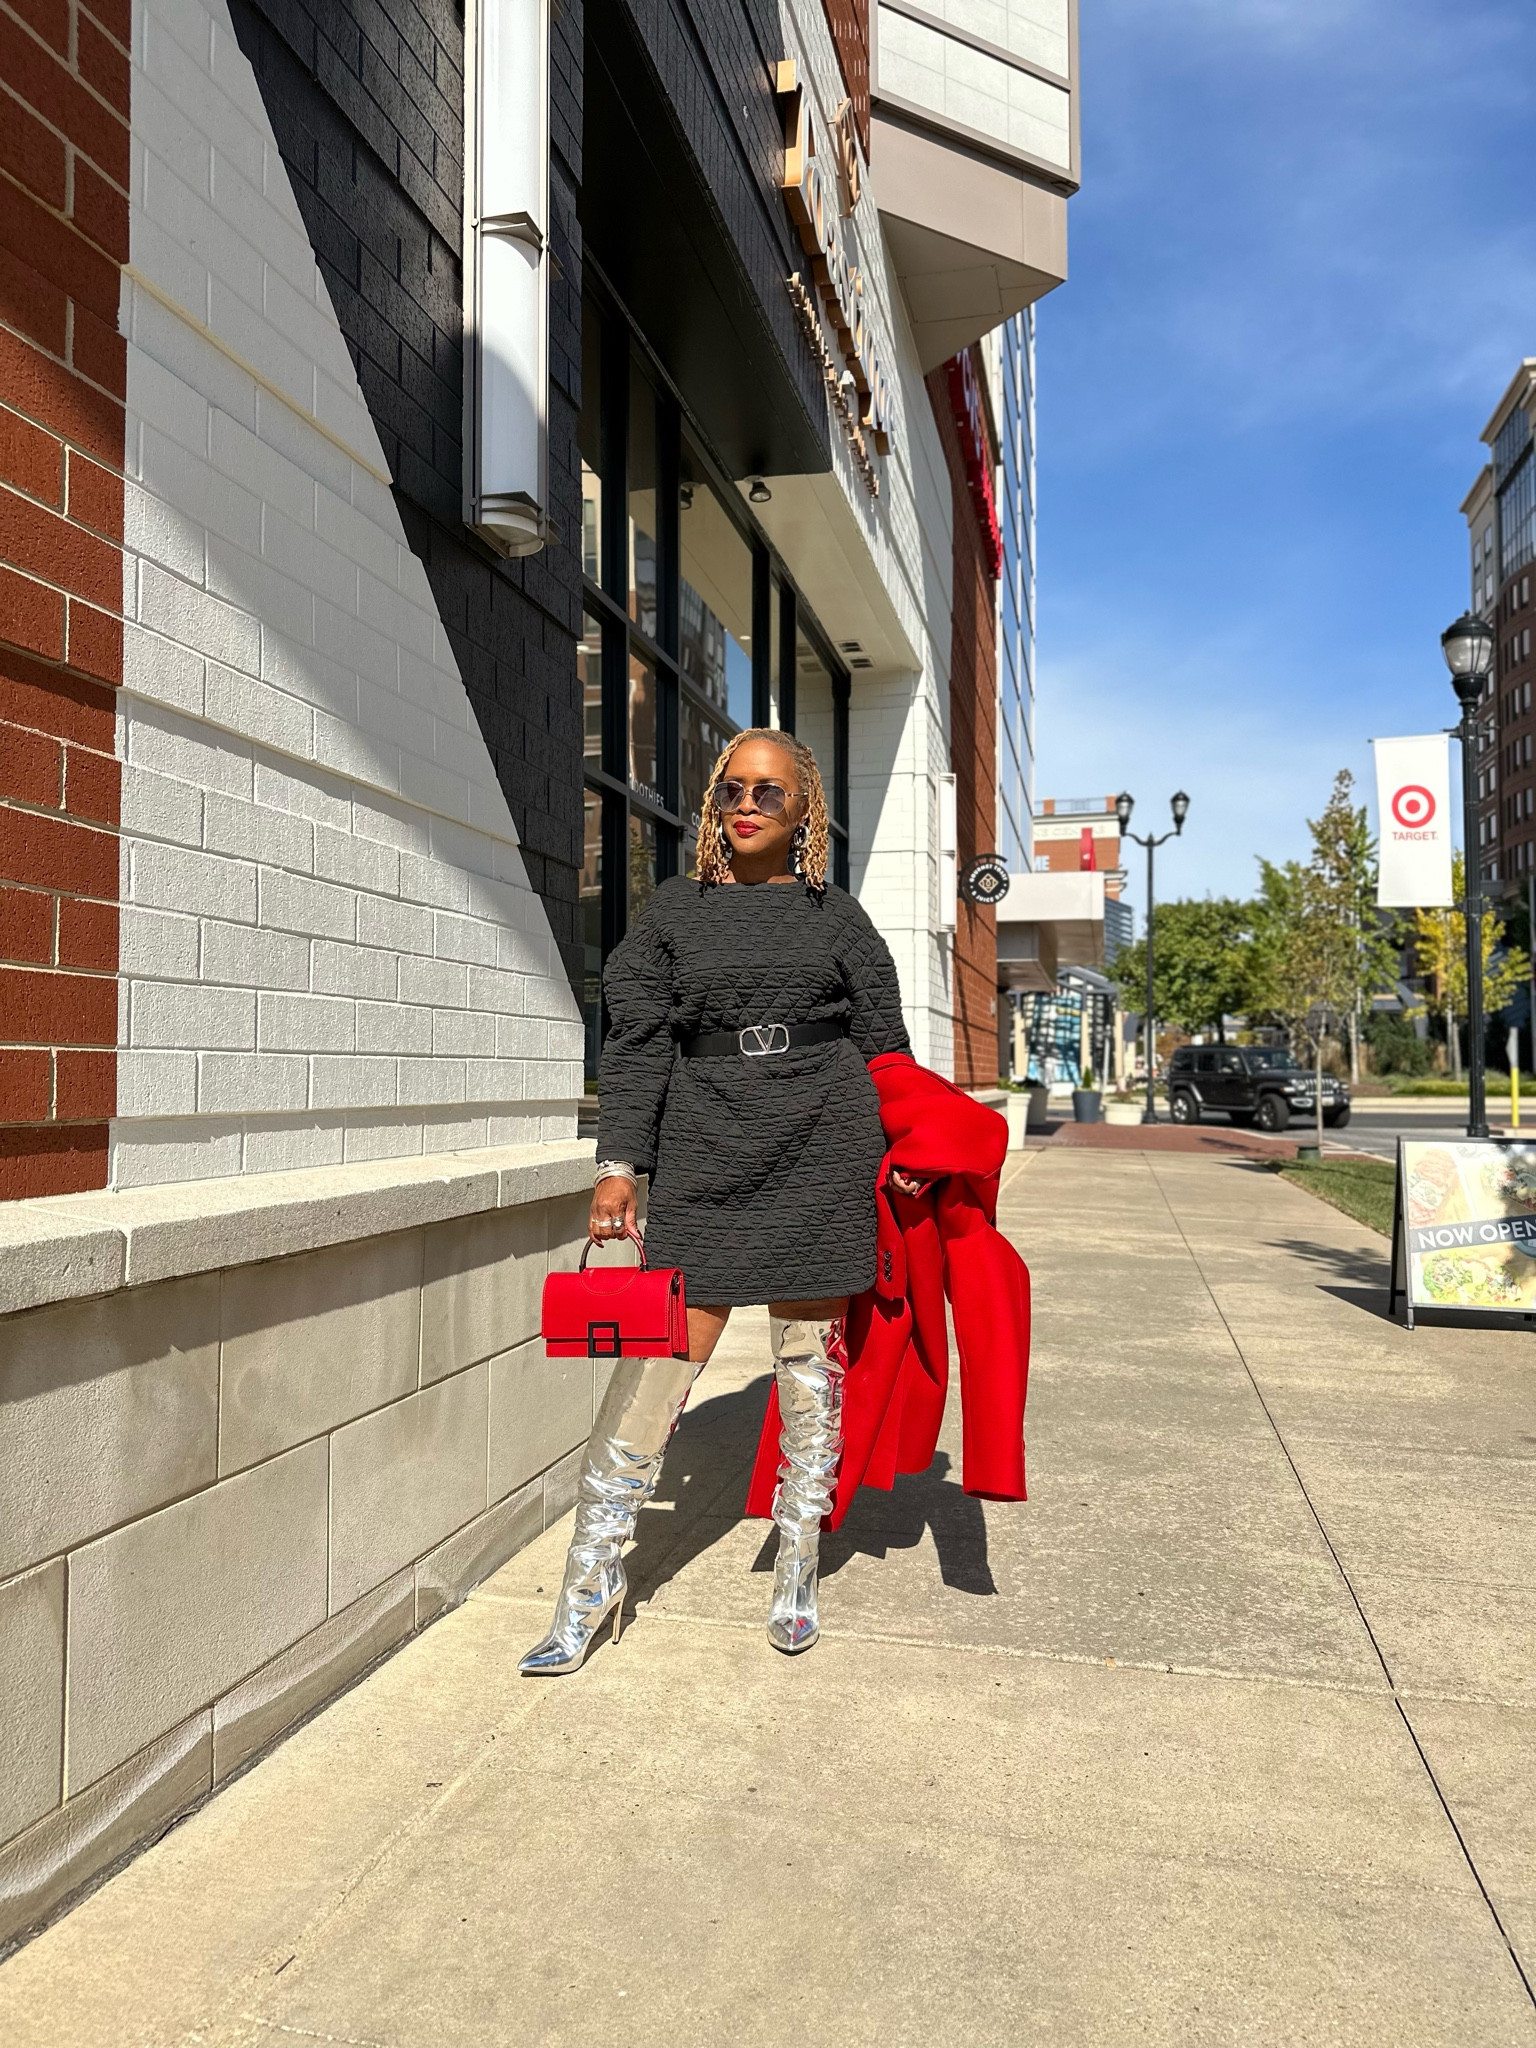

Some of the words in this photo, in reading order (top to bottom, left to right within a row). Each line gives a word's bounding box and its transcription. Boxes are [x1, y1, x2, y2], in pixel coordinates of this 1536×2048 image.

[629, 775, 665, 809] OOTHIES
[1391, 831, 1437, 841] TARGET
[969, 863, 993, 882] GOURMET
[994, 865, 1007, 880] TOAST
[995, 889, 1006, 900] BAR
[1418, 1226, 1473, 1249] NOW
[1479, 1220, 1536, 1242] OPEN
